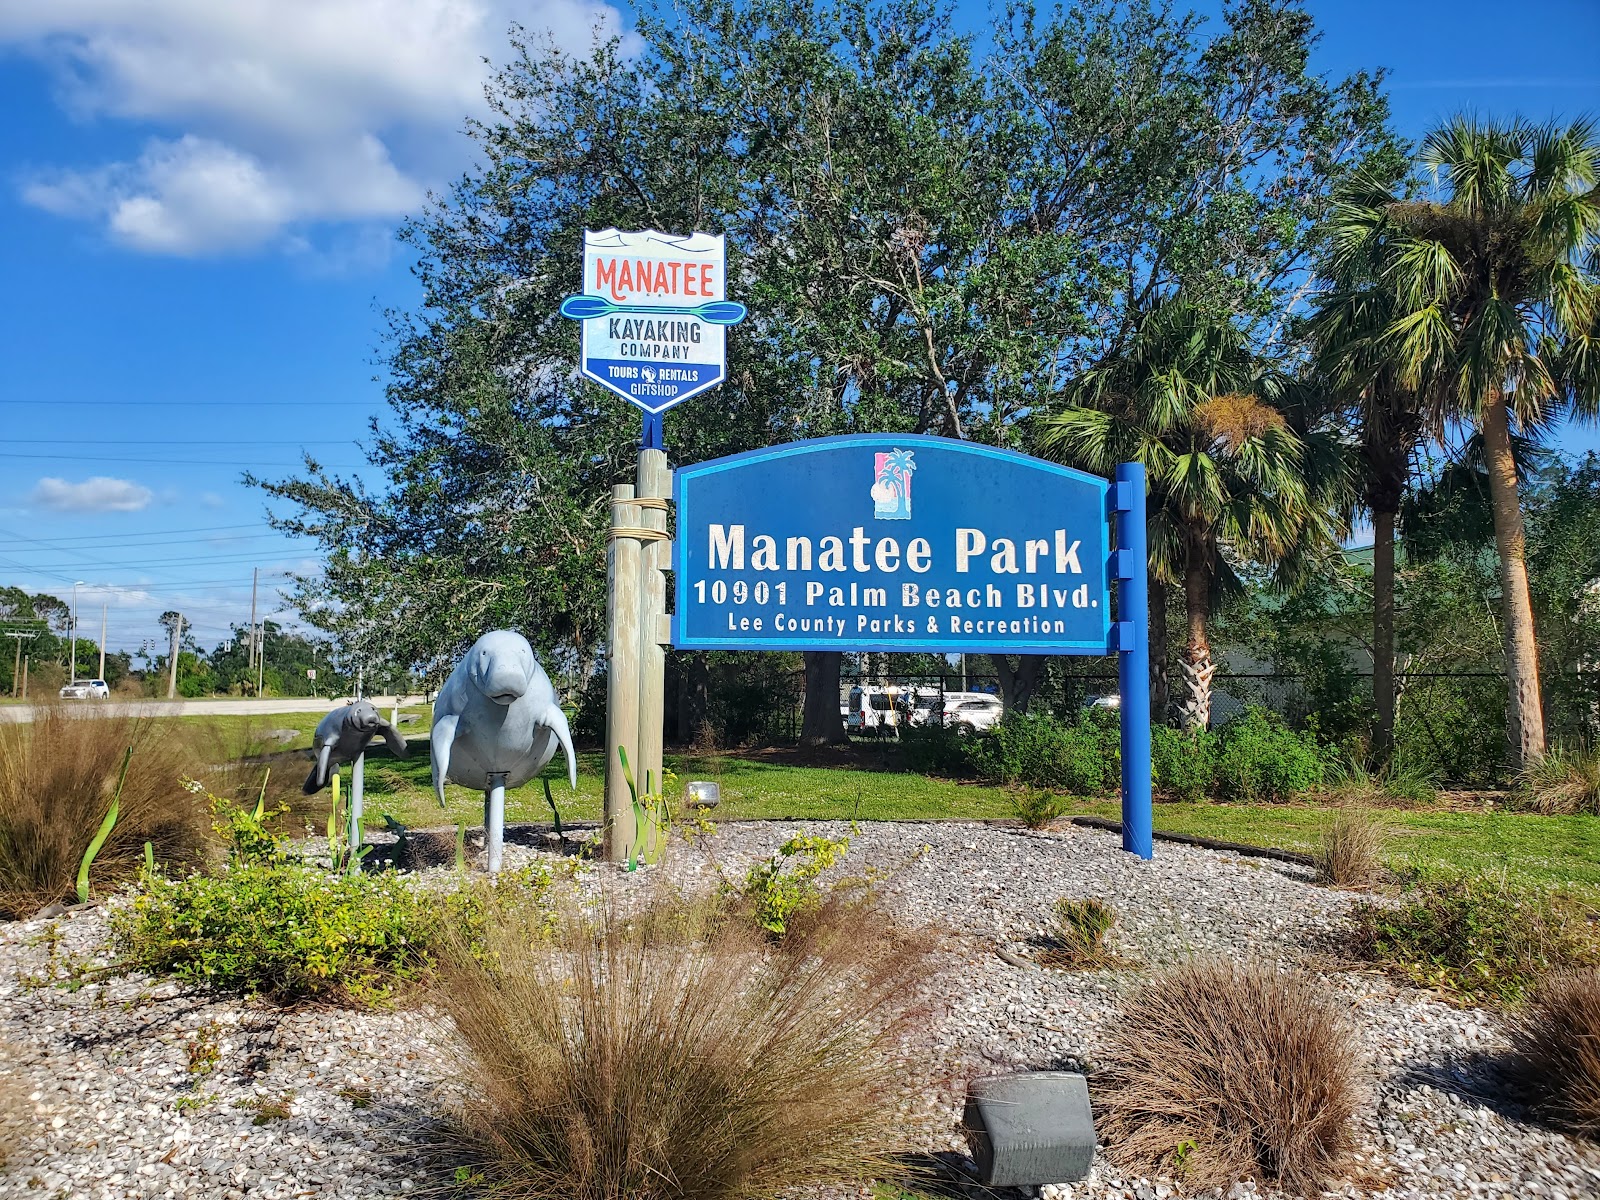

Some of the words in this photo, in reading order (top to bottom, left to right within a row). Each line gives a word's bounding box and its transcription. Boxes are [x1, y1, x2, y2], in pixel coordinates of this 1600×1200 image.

[596, 258, 714, 300] MANATEE
[609, 318, 701, 343] KAYAKING
[620, 343, 689, 359] COMPANY
[609, 366, 638, 378] TOURS
[659, 368, 698, 381] RENTALS
[631, 383, 678, 396] GIFTSHOP
[708, 524, 932, 573] Manatee
[956, 528, 1083, 574] Park
[693, 579, 787, 605] 10901
[807, 582, 887, 607] Palm
[902, 583, 1002, 608] Beach
[1017, 584, 1098, 608] Blvd.
[729, 614, 763, 632] Lee
[775, 615, 845, 636] County
[858, 615, 915, 633] Parks
[927, 616, 939, 634] &
[950, 616, 1065, 634] Recreation
